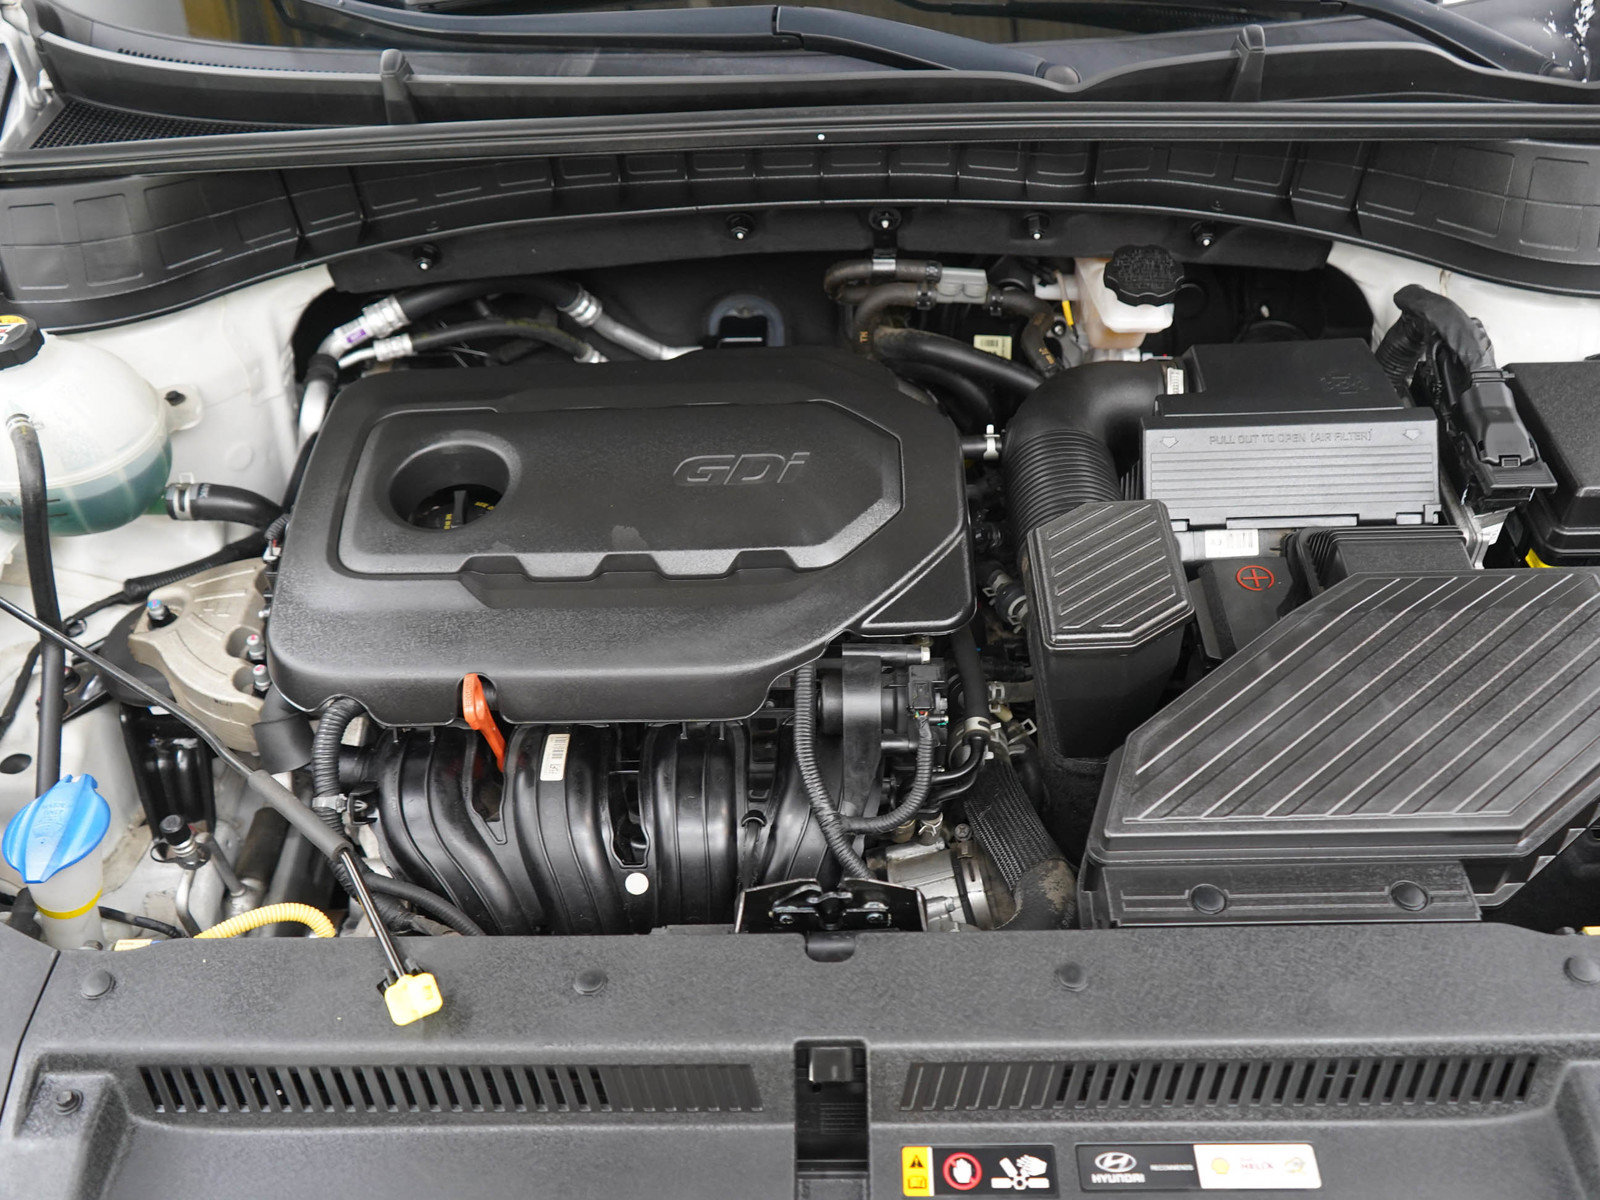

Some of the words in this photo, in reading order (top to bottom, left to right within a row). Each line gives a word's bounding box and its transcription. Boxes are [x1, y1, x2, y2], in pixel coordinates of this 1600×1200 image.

[1209, 435, 1236, 445] PULL
[1238, 434, 1259, 444] OUT
[1261, 433, 1275, 443] TO
[1278, 433, 1306, 443] OPEN
[672, 452, 810, 486] GDi
[1091, 1172, 1146, 1184] HYUNDAI
